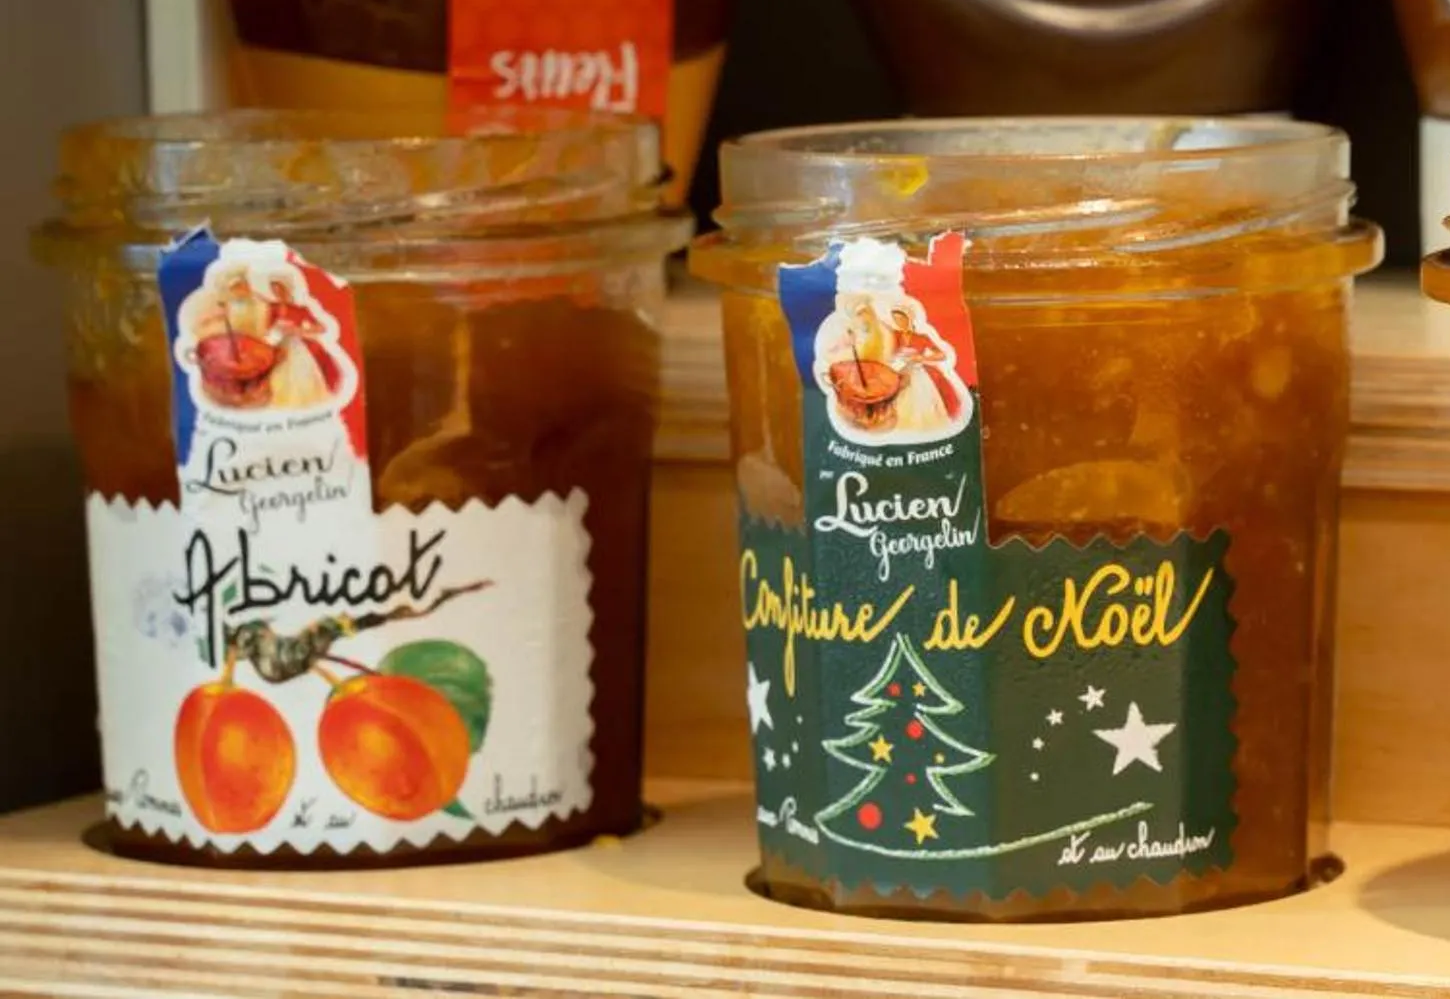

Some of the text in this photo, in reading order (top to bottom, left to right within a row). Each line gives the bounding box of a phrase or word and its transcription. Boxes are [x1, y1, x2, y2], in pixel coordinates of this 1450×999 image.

[490, 40, 640, 114] Fleurs
[186, 437, 340, 496] Lucien
[827, 440, 954, 467] Fabriqué en France
[813, 470, 968, 539] Lucien
[868, 505, 981, 582] Georgelin
[172, 527, 447, 669] Abricot
[739, 548, 1214, 698] Confiture de Noël
[1057, 831, 1091, 866] et
[1089, 842, 1126, 864] au
